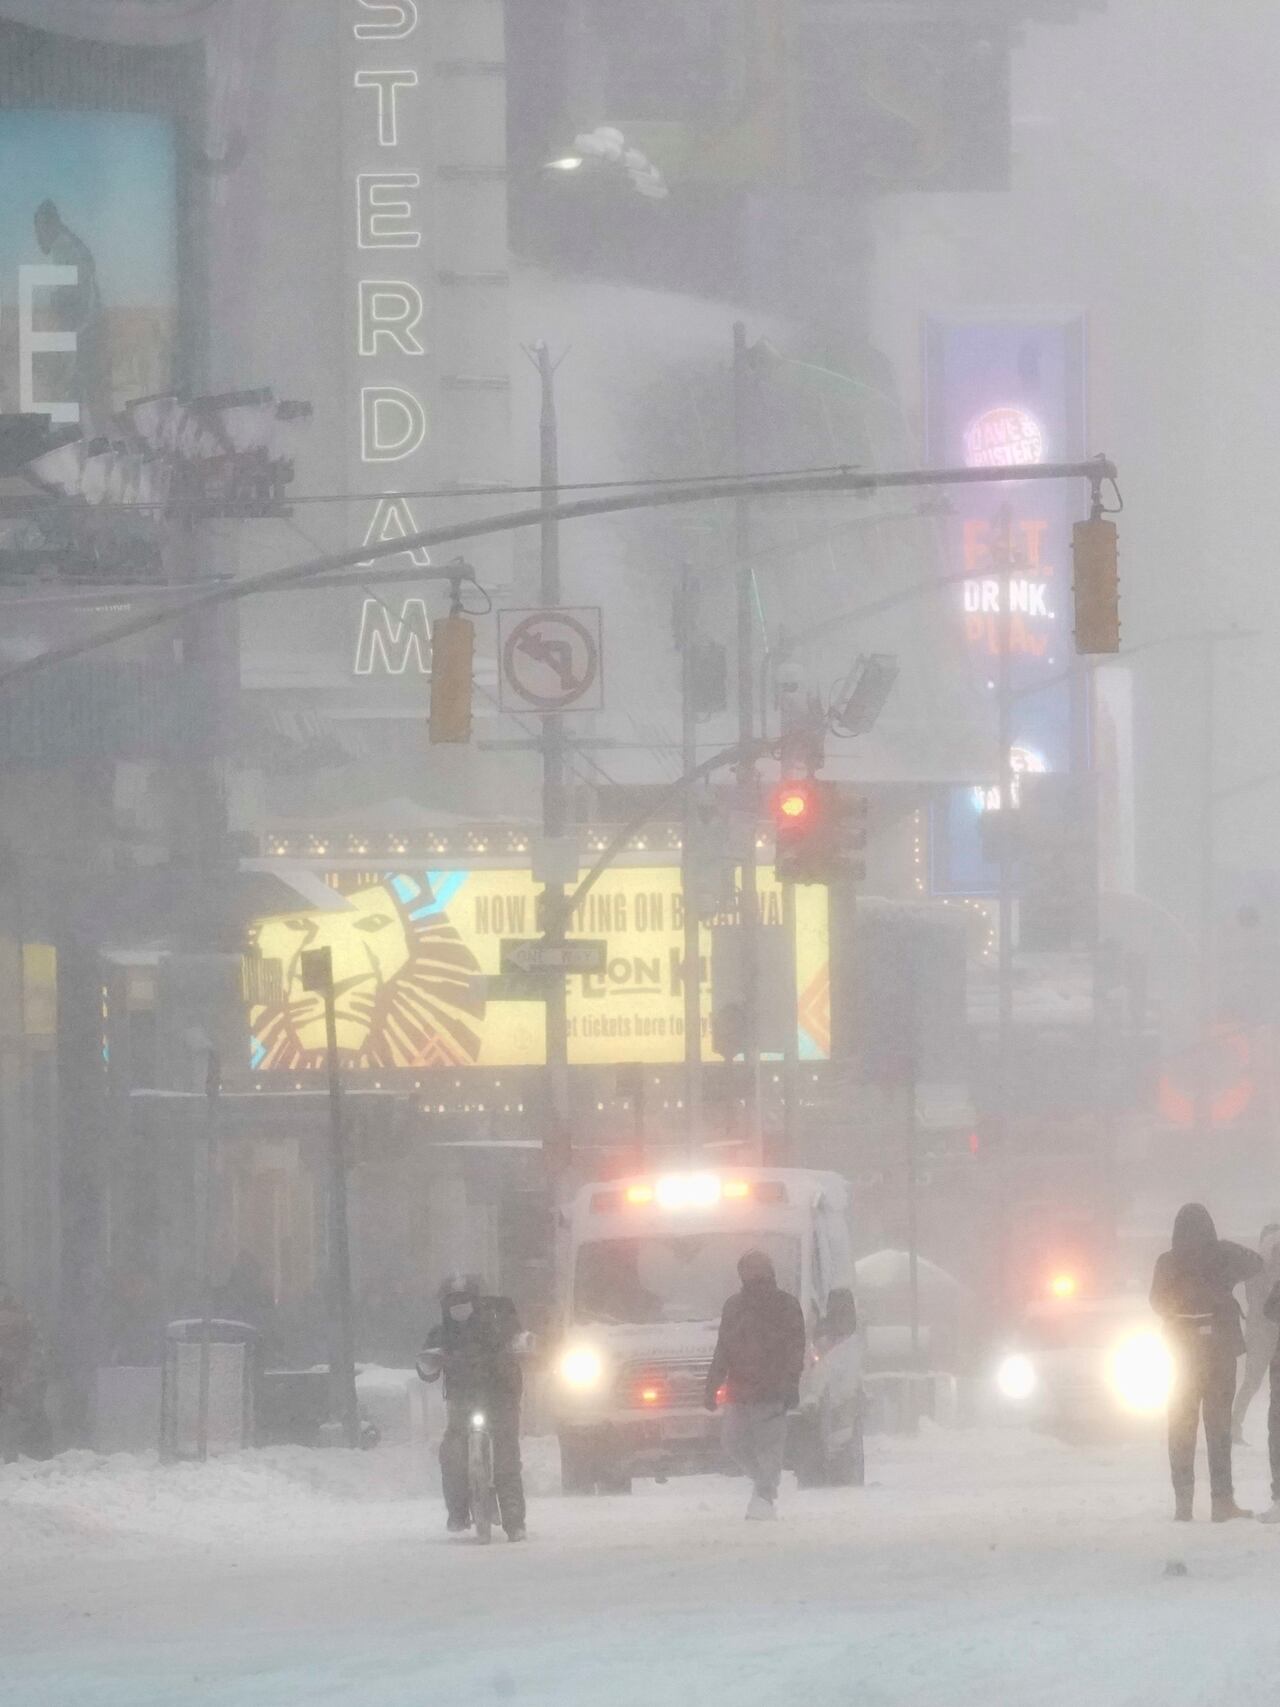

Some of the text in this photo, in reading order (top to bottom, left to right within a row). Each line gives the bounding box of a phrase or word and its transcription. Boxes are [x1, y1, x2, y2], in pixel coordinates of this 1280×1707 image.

[972, 417, 1020, 451] DAVE
[963, 520, 1054, 577] ET.
[963, 579, 1055, 619] DRNK.
[475, 894, 526, 934] NOW
[534, 892, 627, 934] PYING
[634, 892, 664, 932] ON
[517, 949, 543, 964] ONE
[582, 1014, 632, 1038] tickets
[634, 1013, 666, 1037] here
